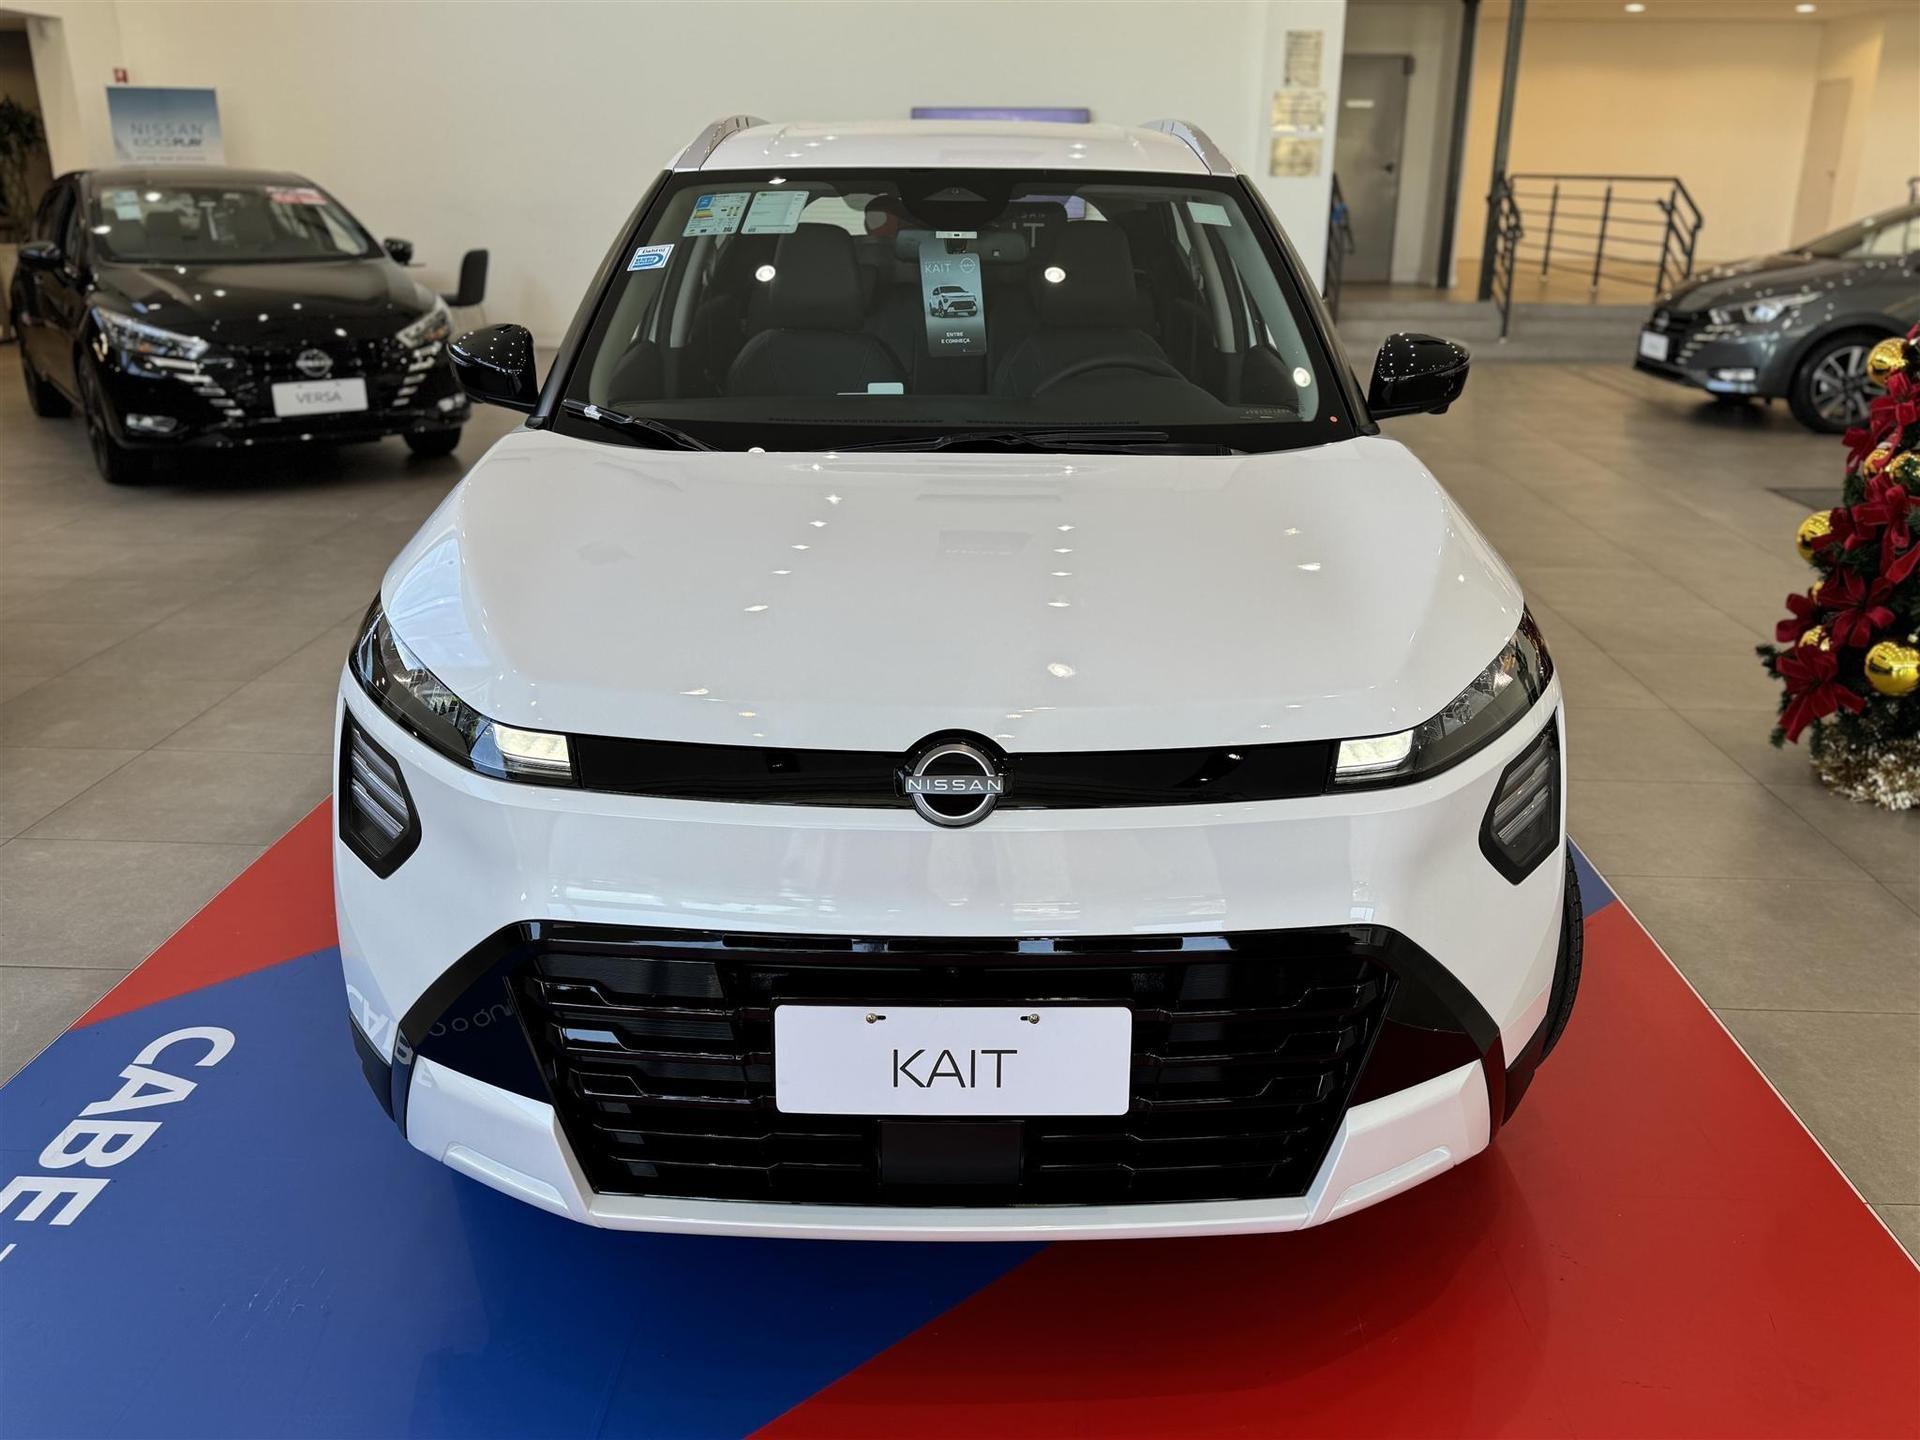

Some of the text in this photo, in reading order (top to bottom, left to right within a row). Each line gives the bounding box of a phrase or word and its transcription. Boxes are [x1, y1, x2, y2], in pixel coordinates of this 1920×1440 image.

[130, 121, 204, 136] NISSAN
[924, 263, 952, 273] KAIT
[295, 390, 342, 404] VERSA
[908, 779, 1001, 791] NISSAN
[892, 1048, 1018, 1090] KAIT
[0, 1026, 236, 1227] CABE
